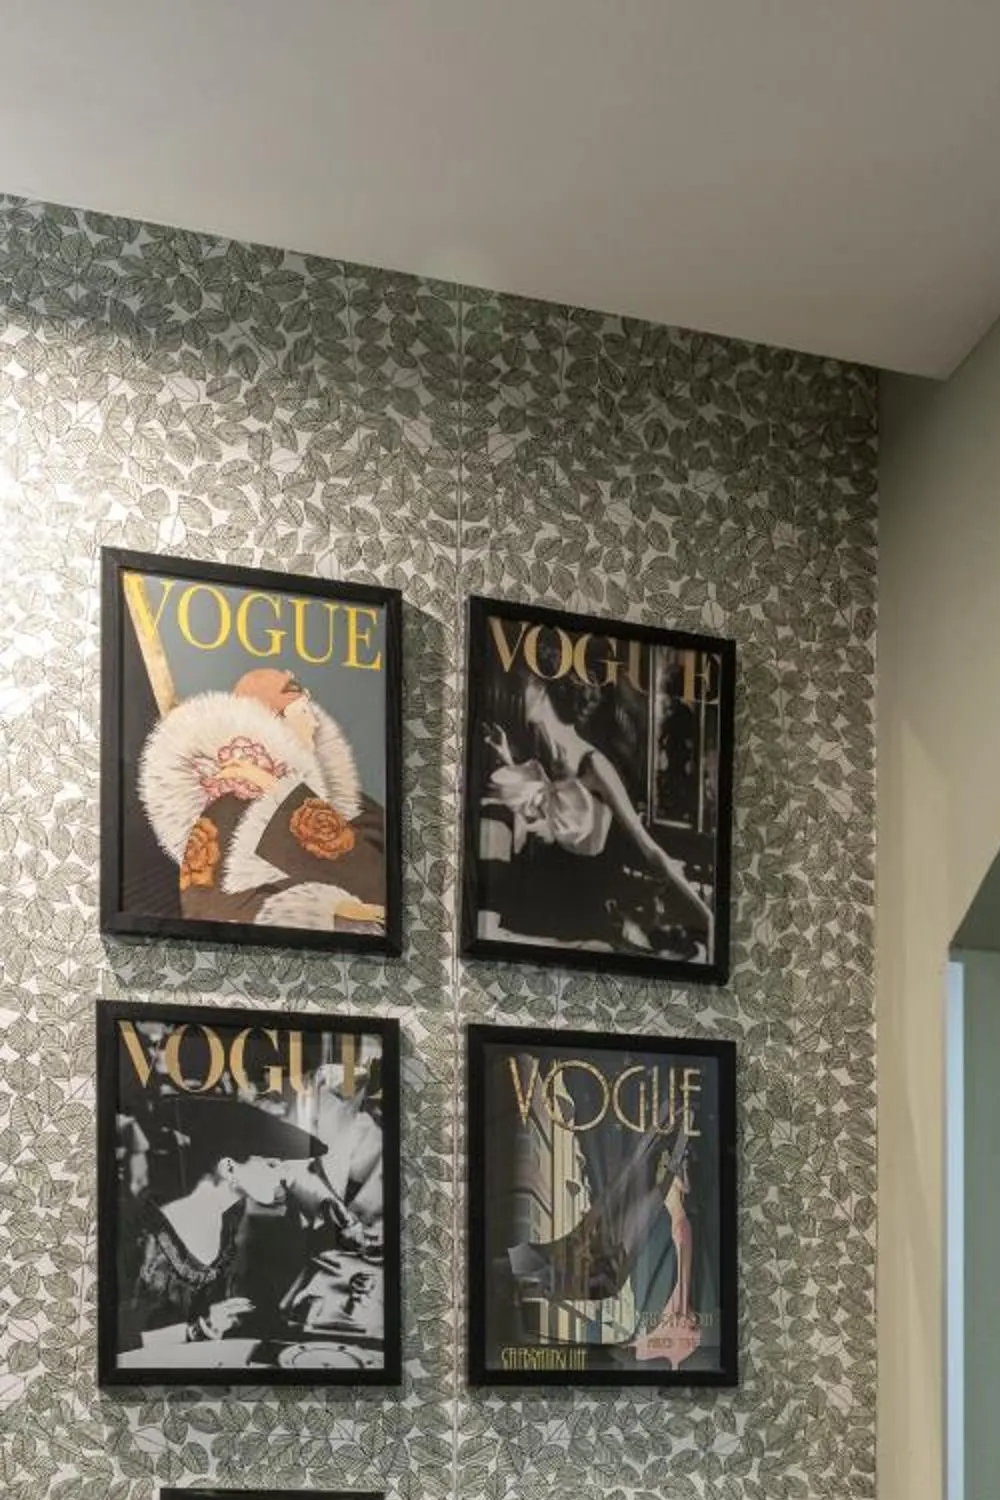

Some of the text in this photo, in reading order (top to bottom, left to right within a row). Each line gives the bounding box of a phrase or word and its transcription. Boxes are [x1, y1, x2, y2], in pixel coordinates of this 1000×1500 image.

[122, 571, 382, 671] VOGUE
[488, 616, 722, 706] VOGUE
[508, 1056, 701, 1137] VOGUE
